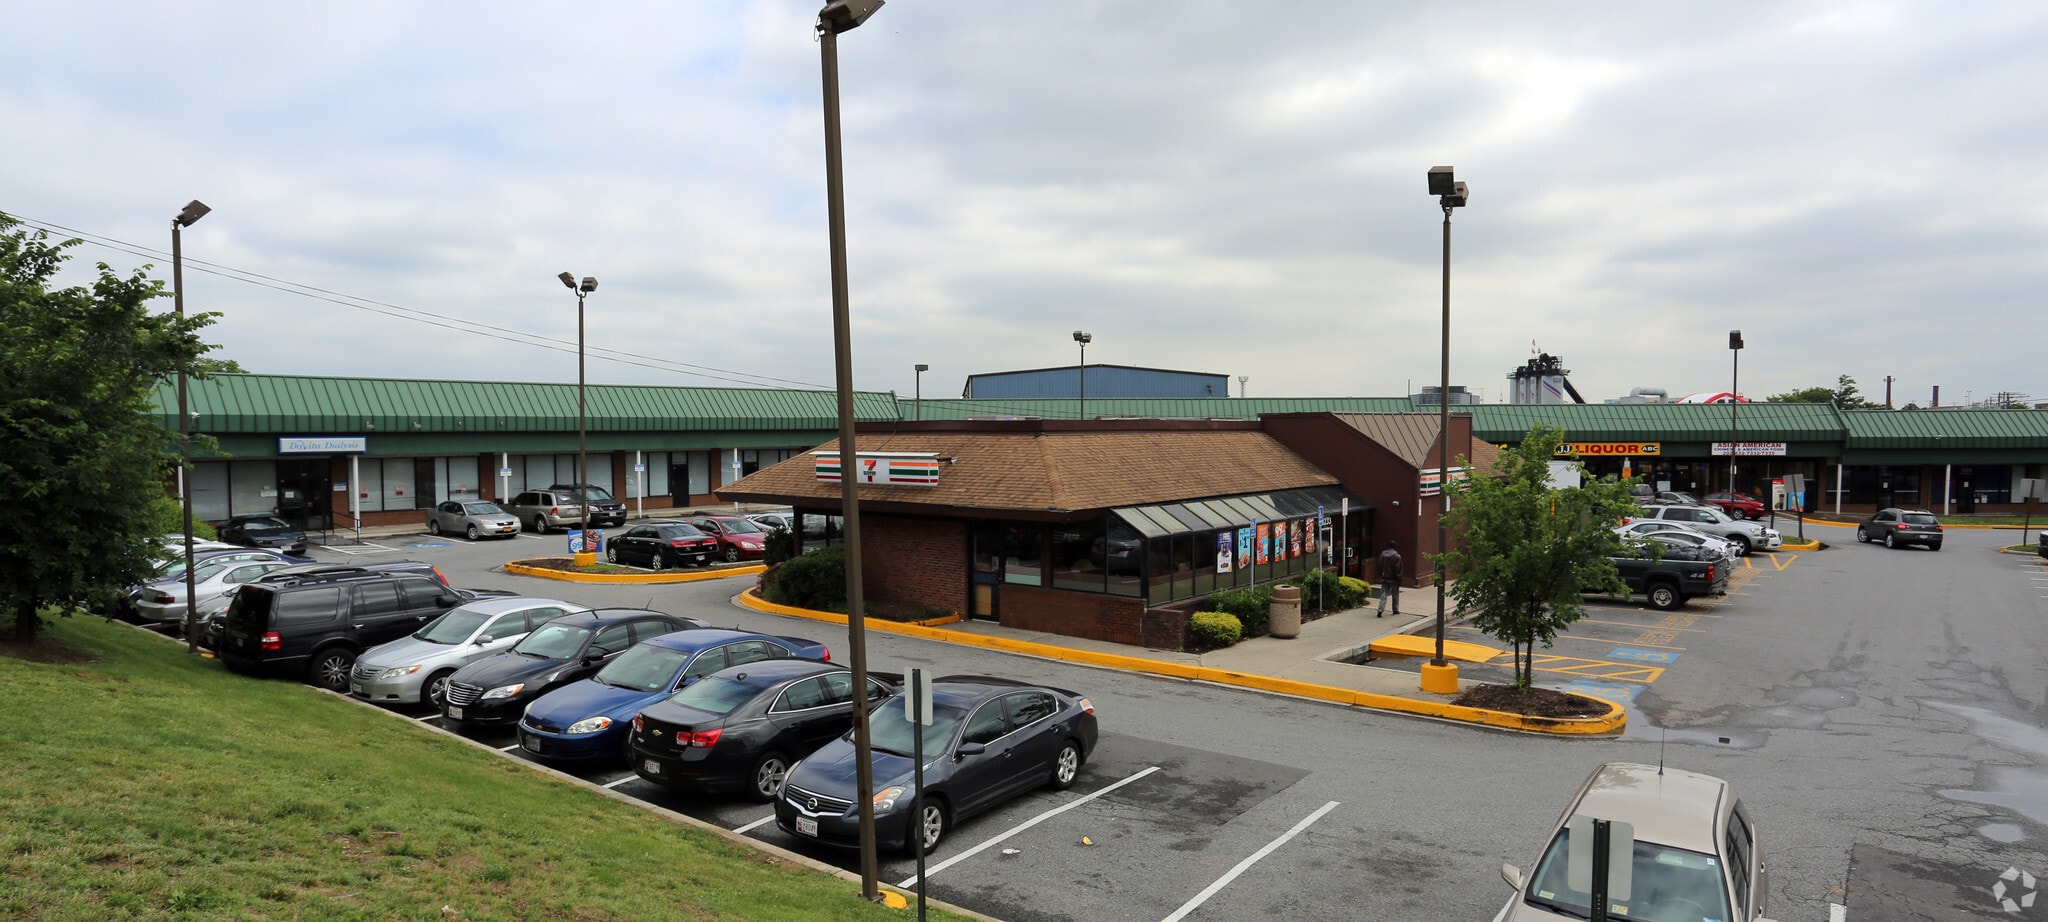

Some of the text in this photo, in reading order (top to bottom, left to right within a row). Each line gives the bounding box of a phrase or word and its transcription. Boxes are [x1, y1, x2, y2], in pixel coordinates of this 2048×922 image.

[290, 440, 359, 450] DaVita Dialysis
[1558, 445, 1570, 453] JJ
[1576, 445, 1639, 454] LIQUOR
[864, 460, 876, 482] 7
